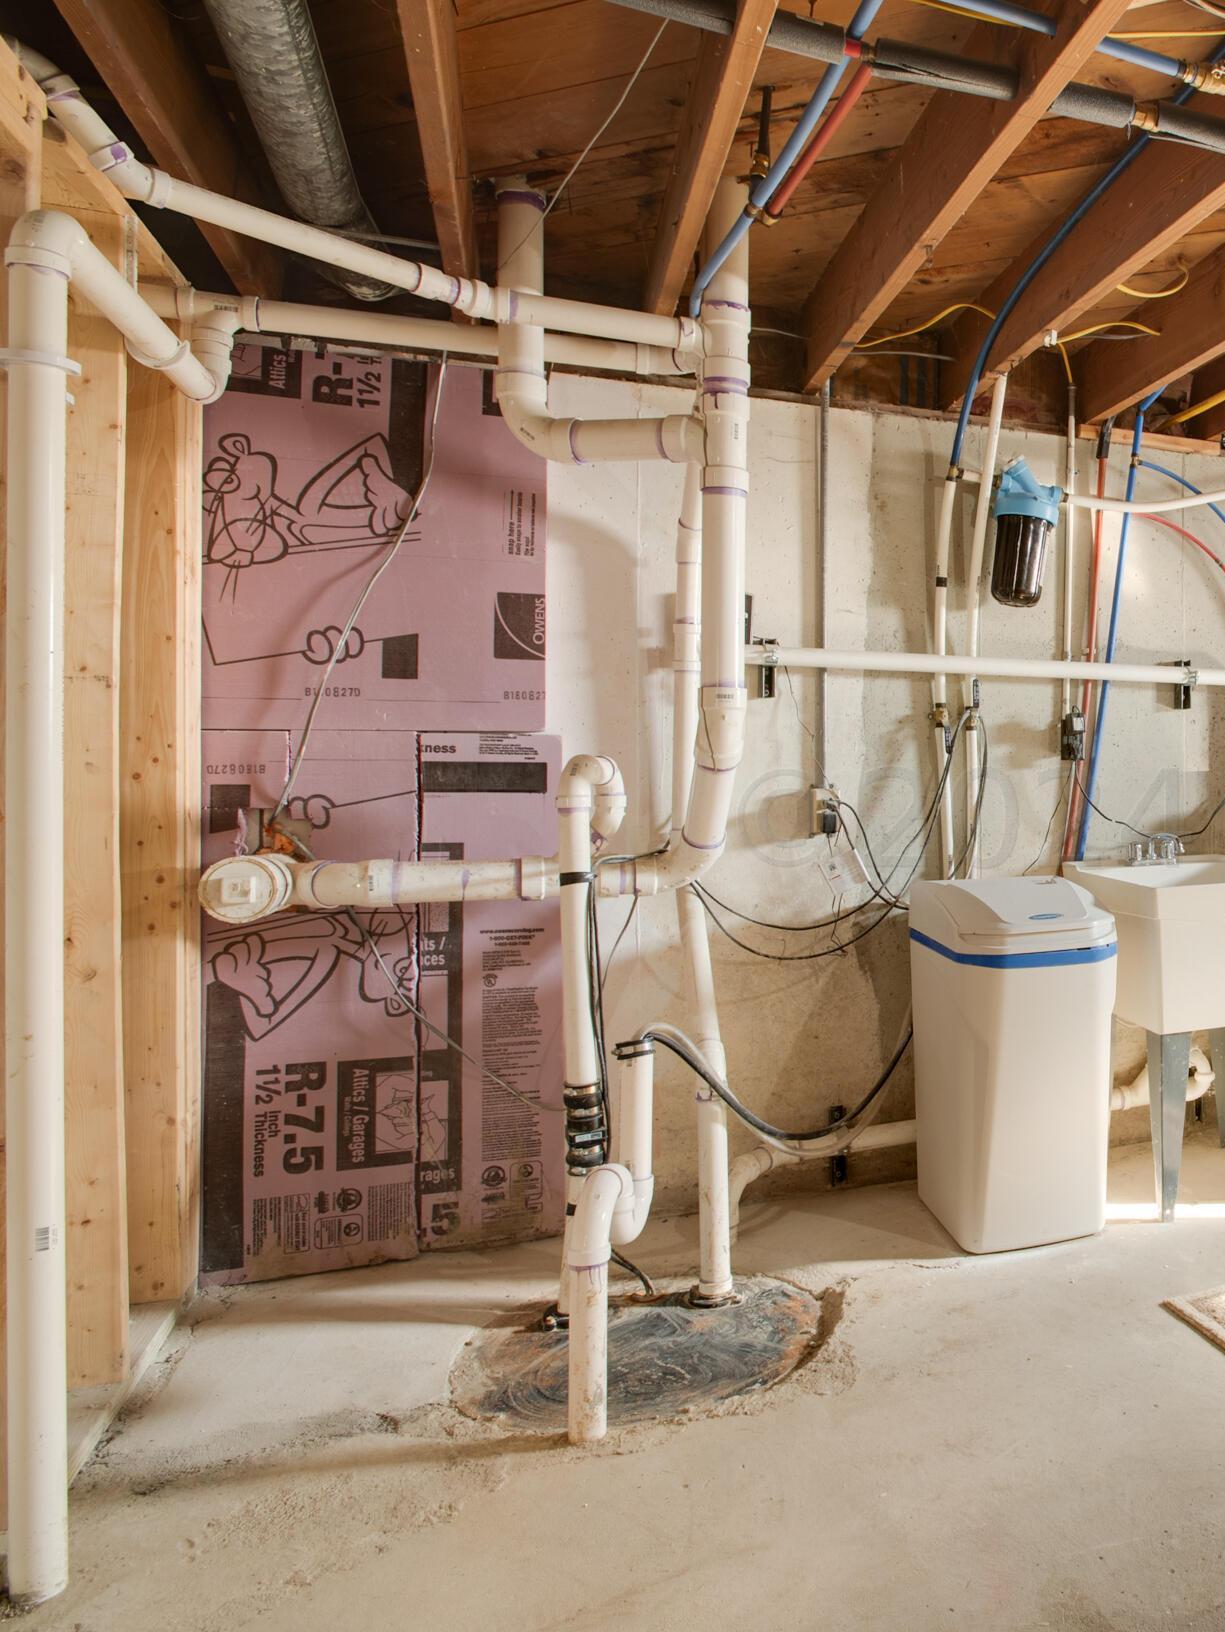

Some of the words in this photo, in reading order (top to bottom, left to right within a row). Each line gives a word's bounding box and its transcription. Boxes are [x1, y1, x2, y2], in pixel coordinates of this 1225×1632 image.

[268, 354, 286, 390] Attics
[532, 597, 546, 645] OWENS
[352, 1068, 369, 1102] Attics
[283, 1060, 327, 1175] R-7.5
[347, 1114, 369, 1163] Garages
[253, 1111, 268, 1178] Thickness
